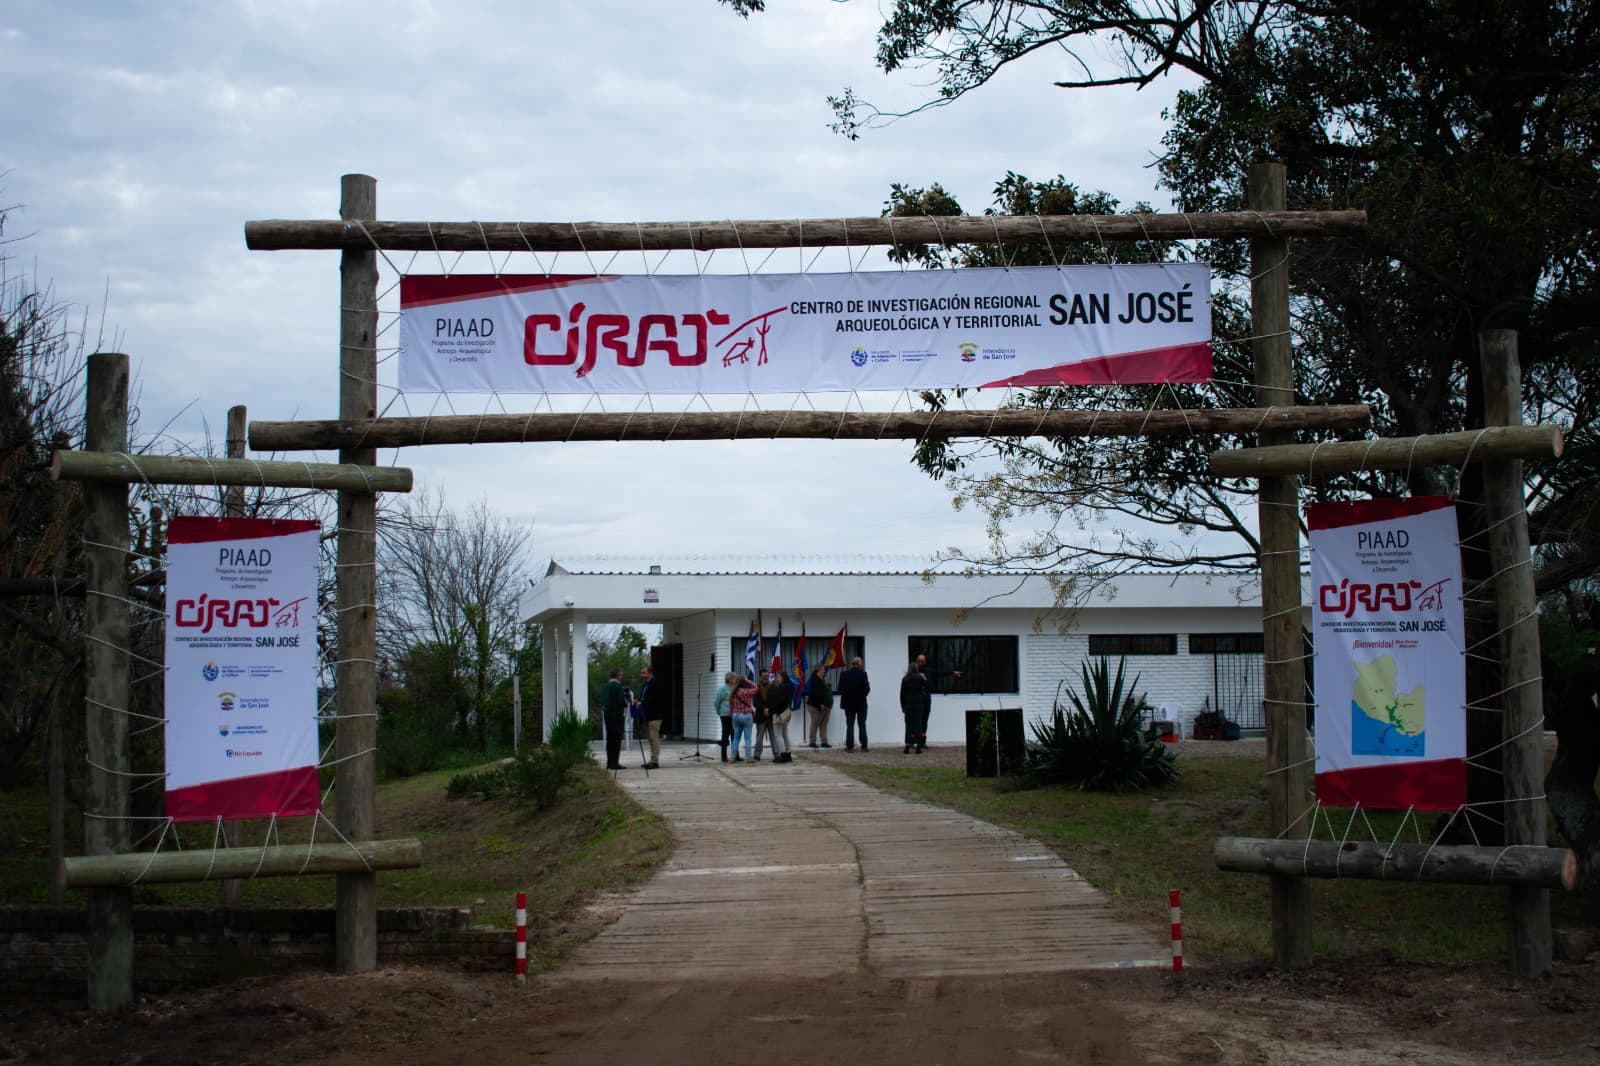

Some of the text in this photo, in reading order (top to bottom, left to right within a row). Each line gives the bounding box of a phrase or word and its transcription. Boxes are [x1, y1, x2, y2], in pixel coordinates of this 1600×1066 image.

[791, 294, 1041, 314] CENTRO DE INVESTIGACIÓN REGIONAL
[1049, 283, 1194, 325] SAN JOSÉ
[436, 318, 494, 337] PIAAD
[836, 314, 1042, 332] ARQUEOLÓGICA Y TERRITORIAL
[1358, 529, 1410, 550] PIAAD
[219, 548, 272, 567] PIAAD
[1399, 617, 1446, 632] SAN JOSÉ
[255, 634, 300, 648] SAN JOSÉ
[1352, 639, 1394, 650] ¡Bienvenidos!
